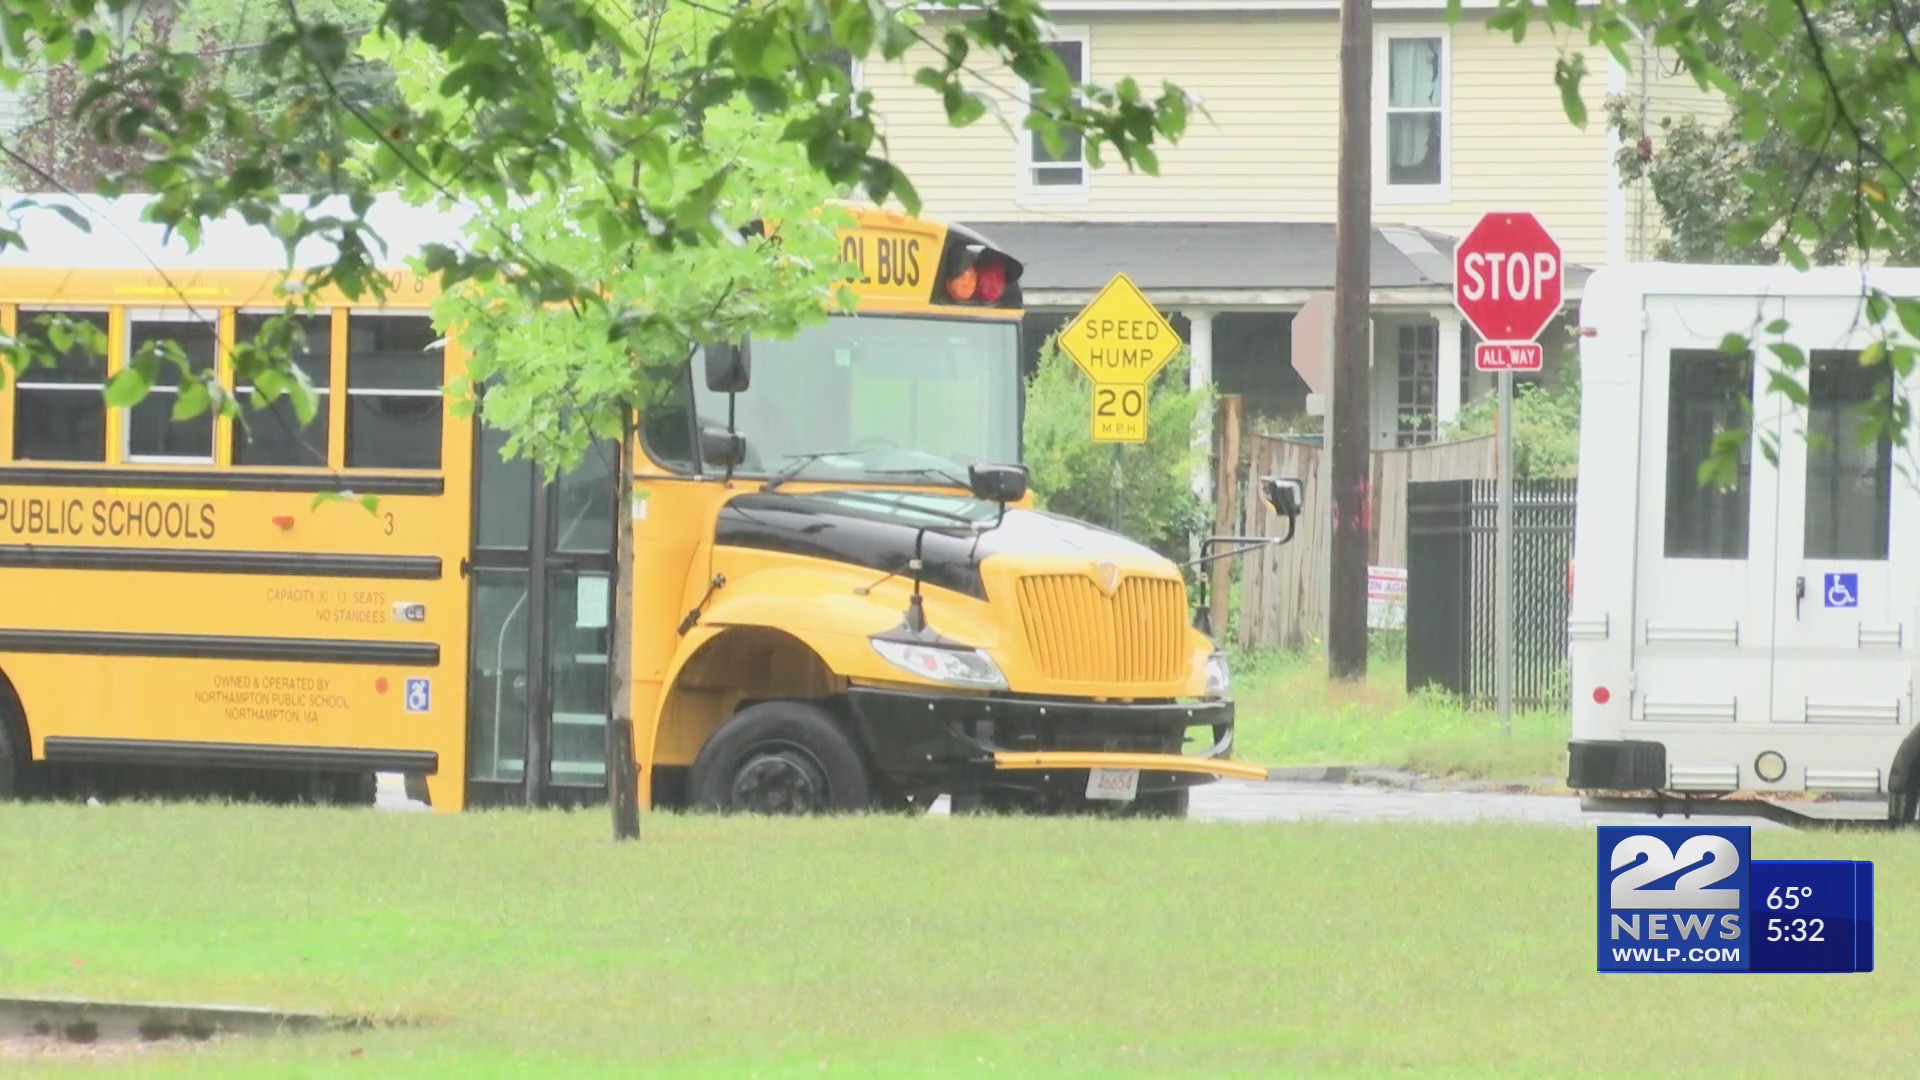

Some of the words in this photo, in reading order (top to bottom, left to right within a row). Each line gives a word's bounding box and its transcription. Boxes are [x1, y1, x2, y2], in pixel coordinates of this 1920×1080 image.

[877, 237, 920, 287] BUS
[1462, 252, 1557, 301] STOP
[1086, 319, 1159, 341] SPEED
[1090, 348, 1153, 368] HUMP
[1483, 349, 1505, 365] ALL
[1509, 349, 1536, 365] WAY
[1097, 389, 1142, 417] 20
[1102, 423, 1136, 433] MPH
[0, 499, 84, 535] PUBLIC
[92, 500, 216, 539] SCHOOLS
[384, 512, 394, 536] 3
[267, 588, 314, 602] CAPACITY
[353, 592, 386, 604] SEATS
[316, 608, 331, 622] NO
[333, 609, 386, 624] STANDEES
[213, 675, 251, 689] OWNED
[252, 676, 260, 689] &
[262, 677, 315, 691] OPERATED
[316, 679, 330, 692] BY
[194, 690, 270, 705] NORTHAMPTON
[271, 693, 307, 707] PUBLIC
[308, 694, 350, 709] SCHOOL
[303, 710, 319, 723] MA
